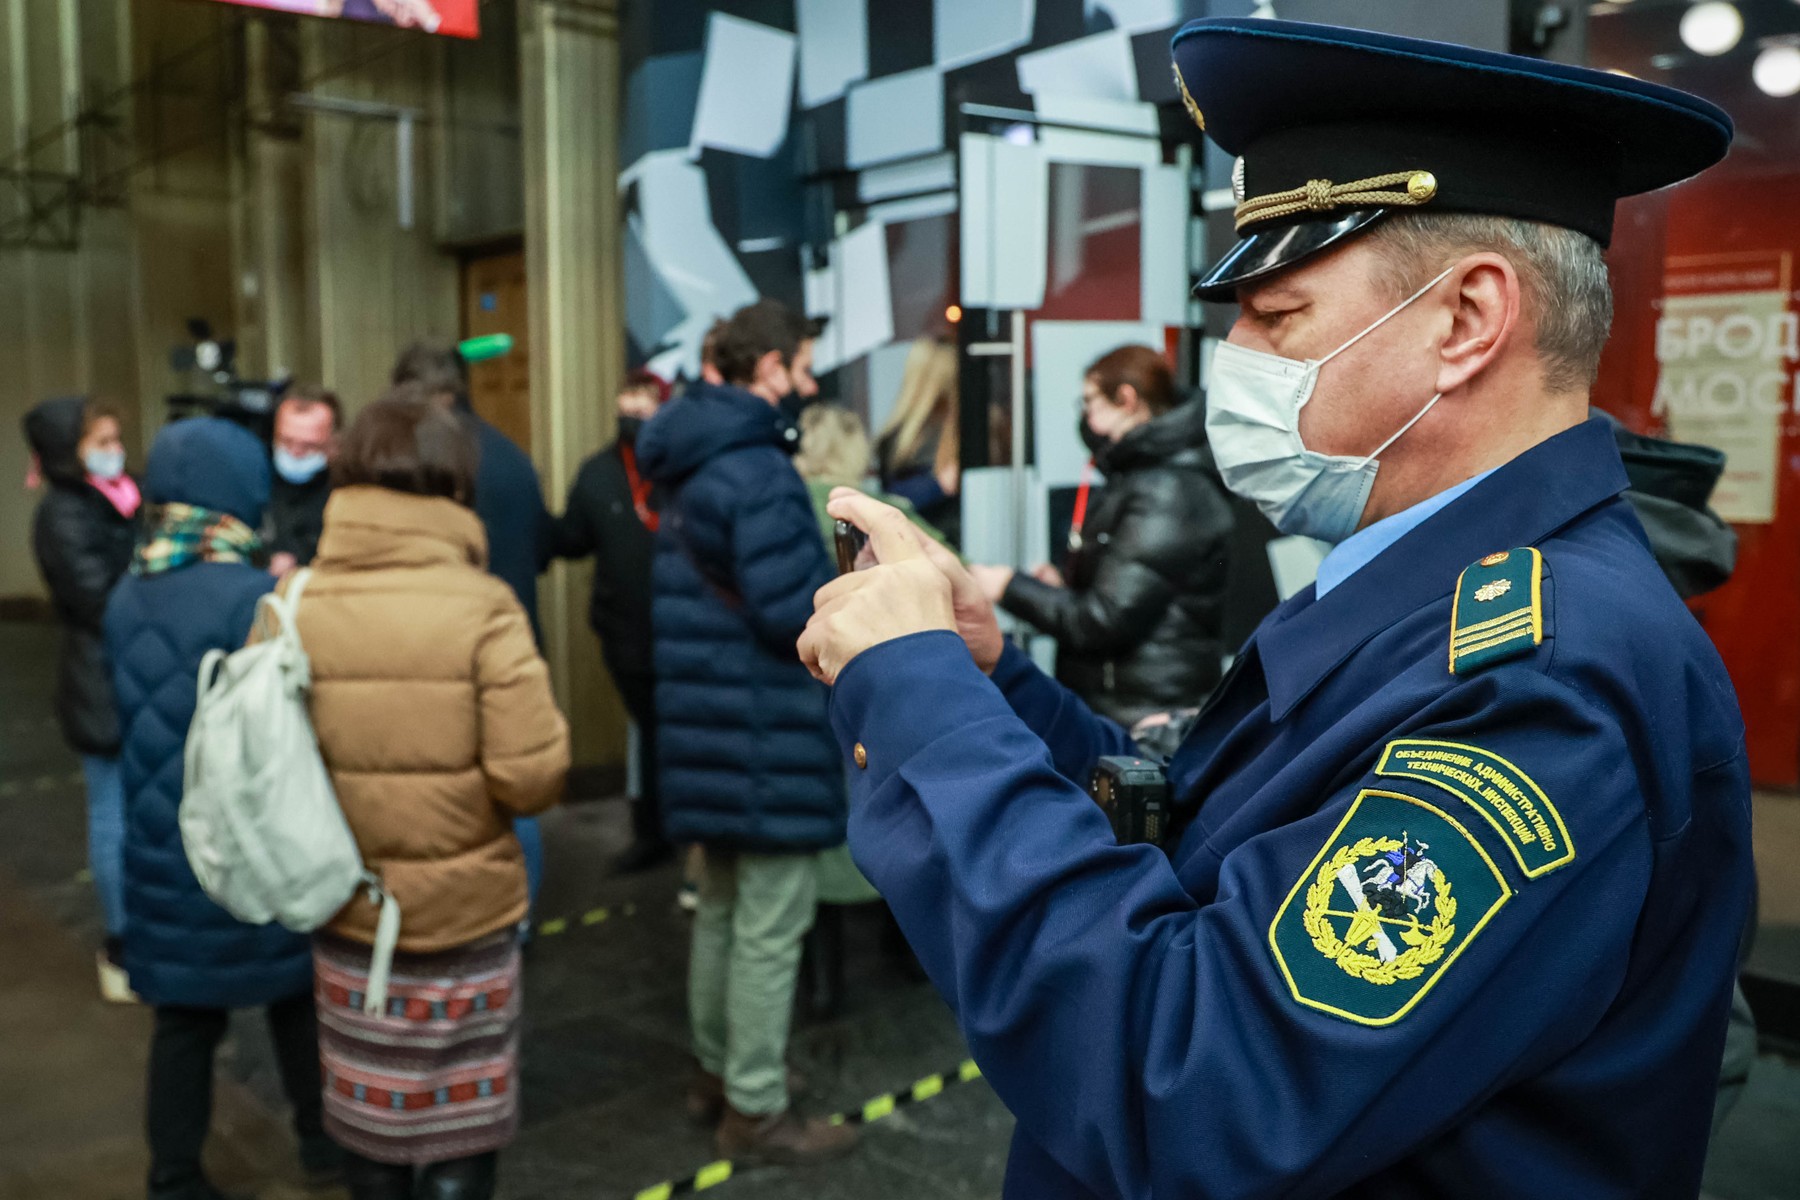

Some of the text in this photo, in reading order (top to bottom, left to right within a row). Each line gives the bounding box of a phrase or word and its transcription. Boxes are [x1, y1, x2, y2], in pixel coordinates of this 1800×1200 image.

[1650, 371, 1800, 416] МОС
[1395, 750, 1556, 852] ОБЪЕДИНЕНИЕ АДМИНИСТРАТИВНО
[1406, 761, 1538, 845] ТЕХНИЧЕСКИХ ИНСПЕКЦИЙ
